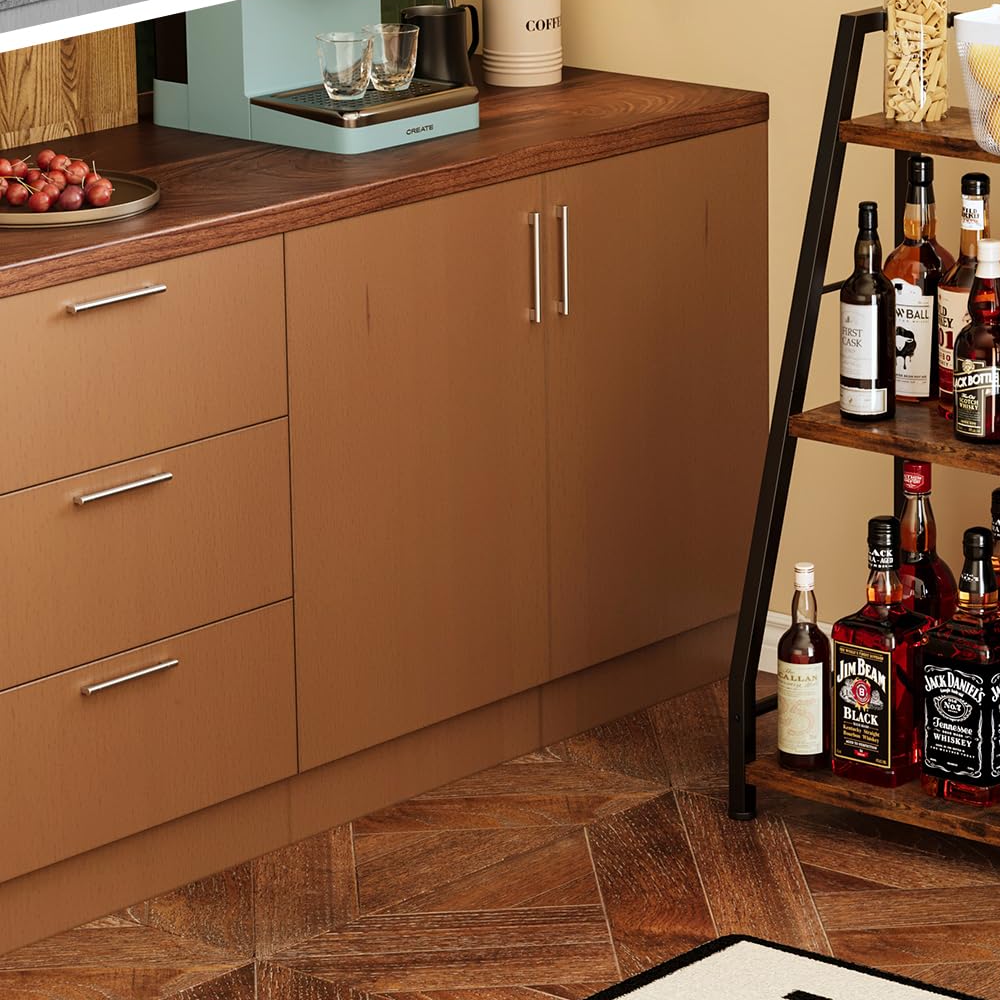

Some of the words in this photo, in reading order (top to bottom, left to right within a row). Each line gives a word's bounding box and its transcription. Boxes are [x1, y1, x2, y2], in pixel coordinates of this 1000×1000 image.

[406, 123, 434, 136] CREATE
[836, 660, 857, 683] JIM
[857, 658, 887, 693] BEAM
[924, 674, 946, 692] JACK
[947, 671, 986, 706] DANIEL'S
[843, 706, 879, 727] BLACK
[932, 716, 973, 736] Tennessee
[932, 732, 973, 748] WHISKEY
